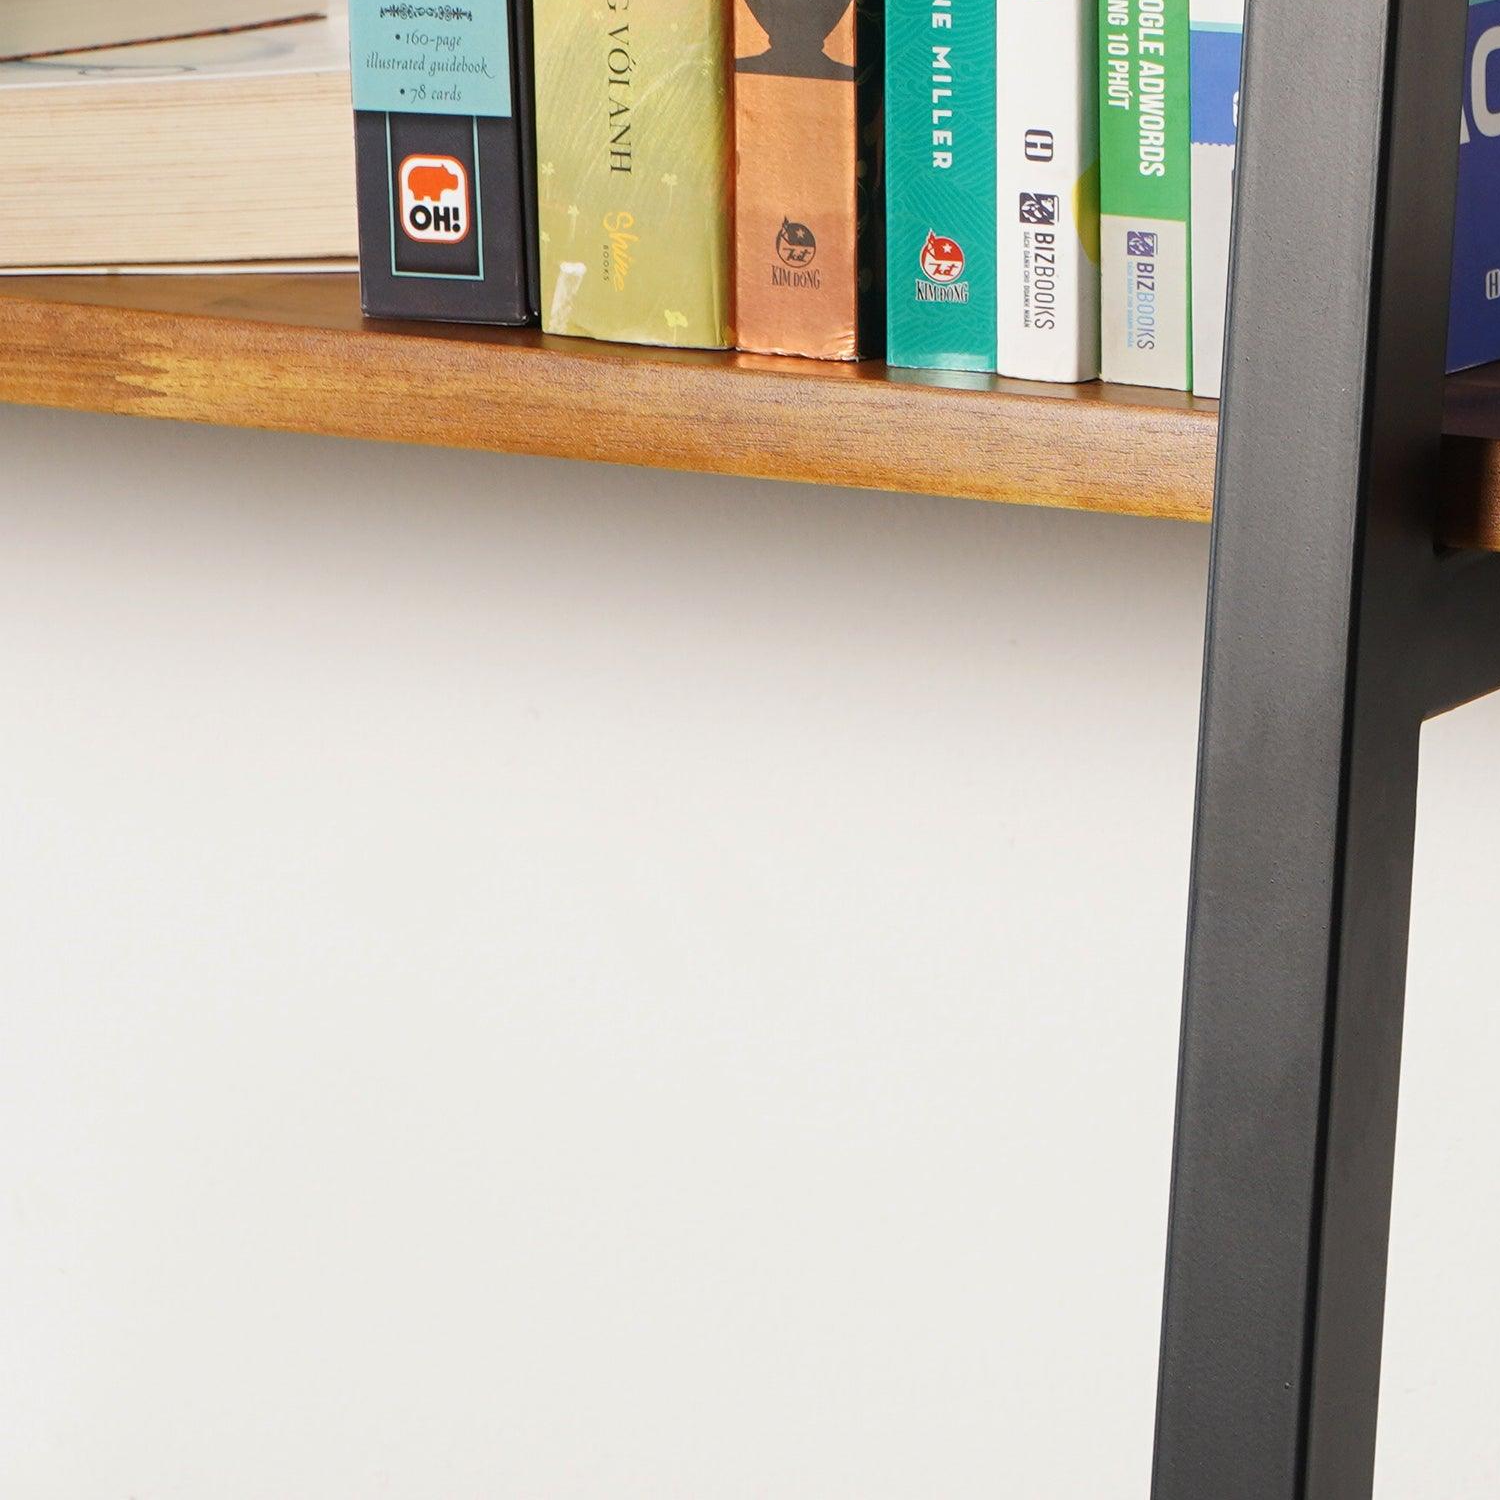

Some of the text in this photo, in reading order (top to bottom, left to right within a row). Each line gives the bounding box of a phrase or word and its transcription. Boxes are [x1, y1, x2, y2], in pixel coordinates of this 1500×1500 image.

[366, 51, 496, 79] illustrated guidebook
[405, 29, 462, 52] 160-page
[606, 23, 636, 87] VỚI
[1107, 32, 1129, 56] 10
[410, 84, 462, 104] 78 cards
[932, 46, 953, 169] MILLER
[1107, 59, 1134, 110] PHÚT
[608, 96, 633, 175] ANH
[1138, 60, 1165, 177] ADWORDS
[408, 204, 461, 233] OH!
[1034, 231, 1056, 331] BIZBOOKS
[1136, 262, 1155, 350] BIZBOOKS
